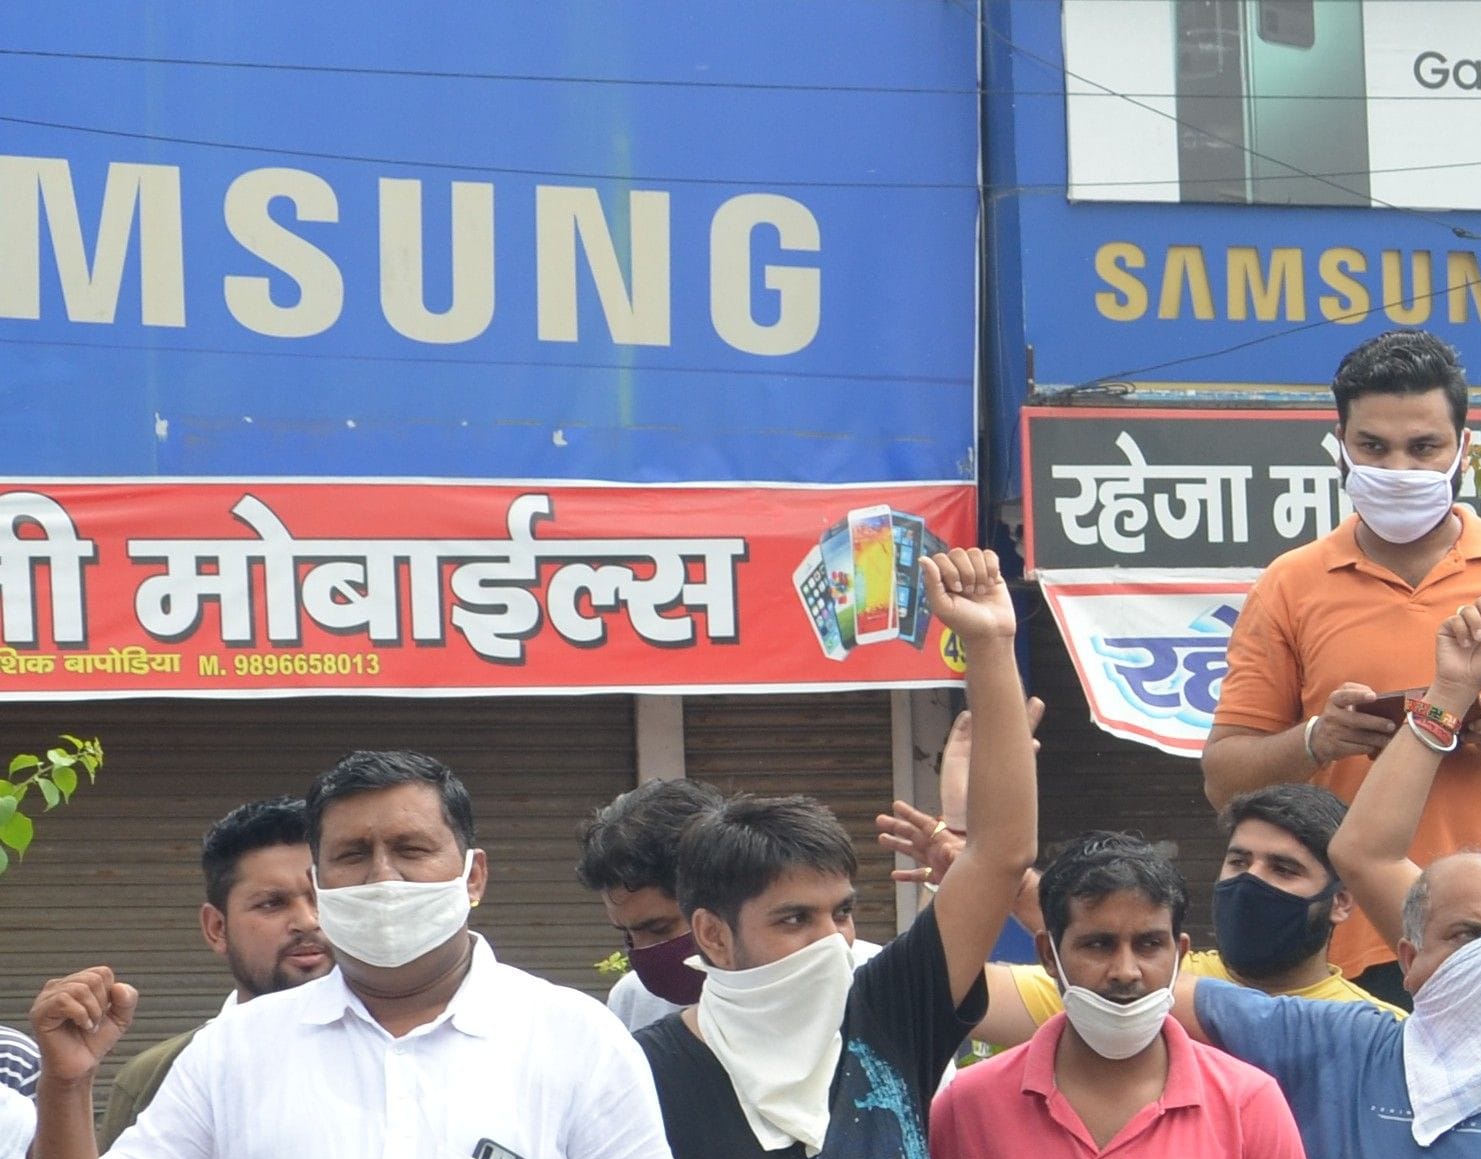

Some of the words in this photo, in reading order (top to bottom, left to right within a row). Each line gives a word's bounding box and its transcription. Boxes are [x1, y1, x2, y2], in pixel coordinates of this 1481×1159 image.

[1052, 431, 1253, 554] रहेजा
[127, 494, 750, 665] मोबाईल्स
[198, 655, 227, 676] M.
[234, 653, 381, 676] 9896658013
